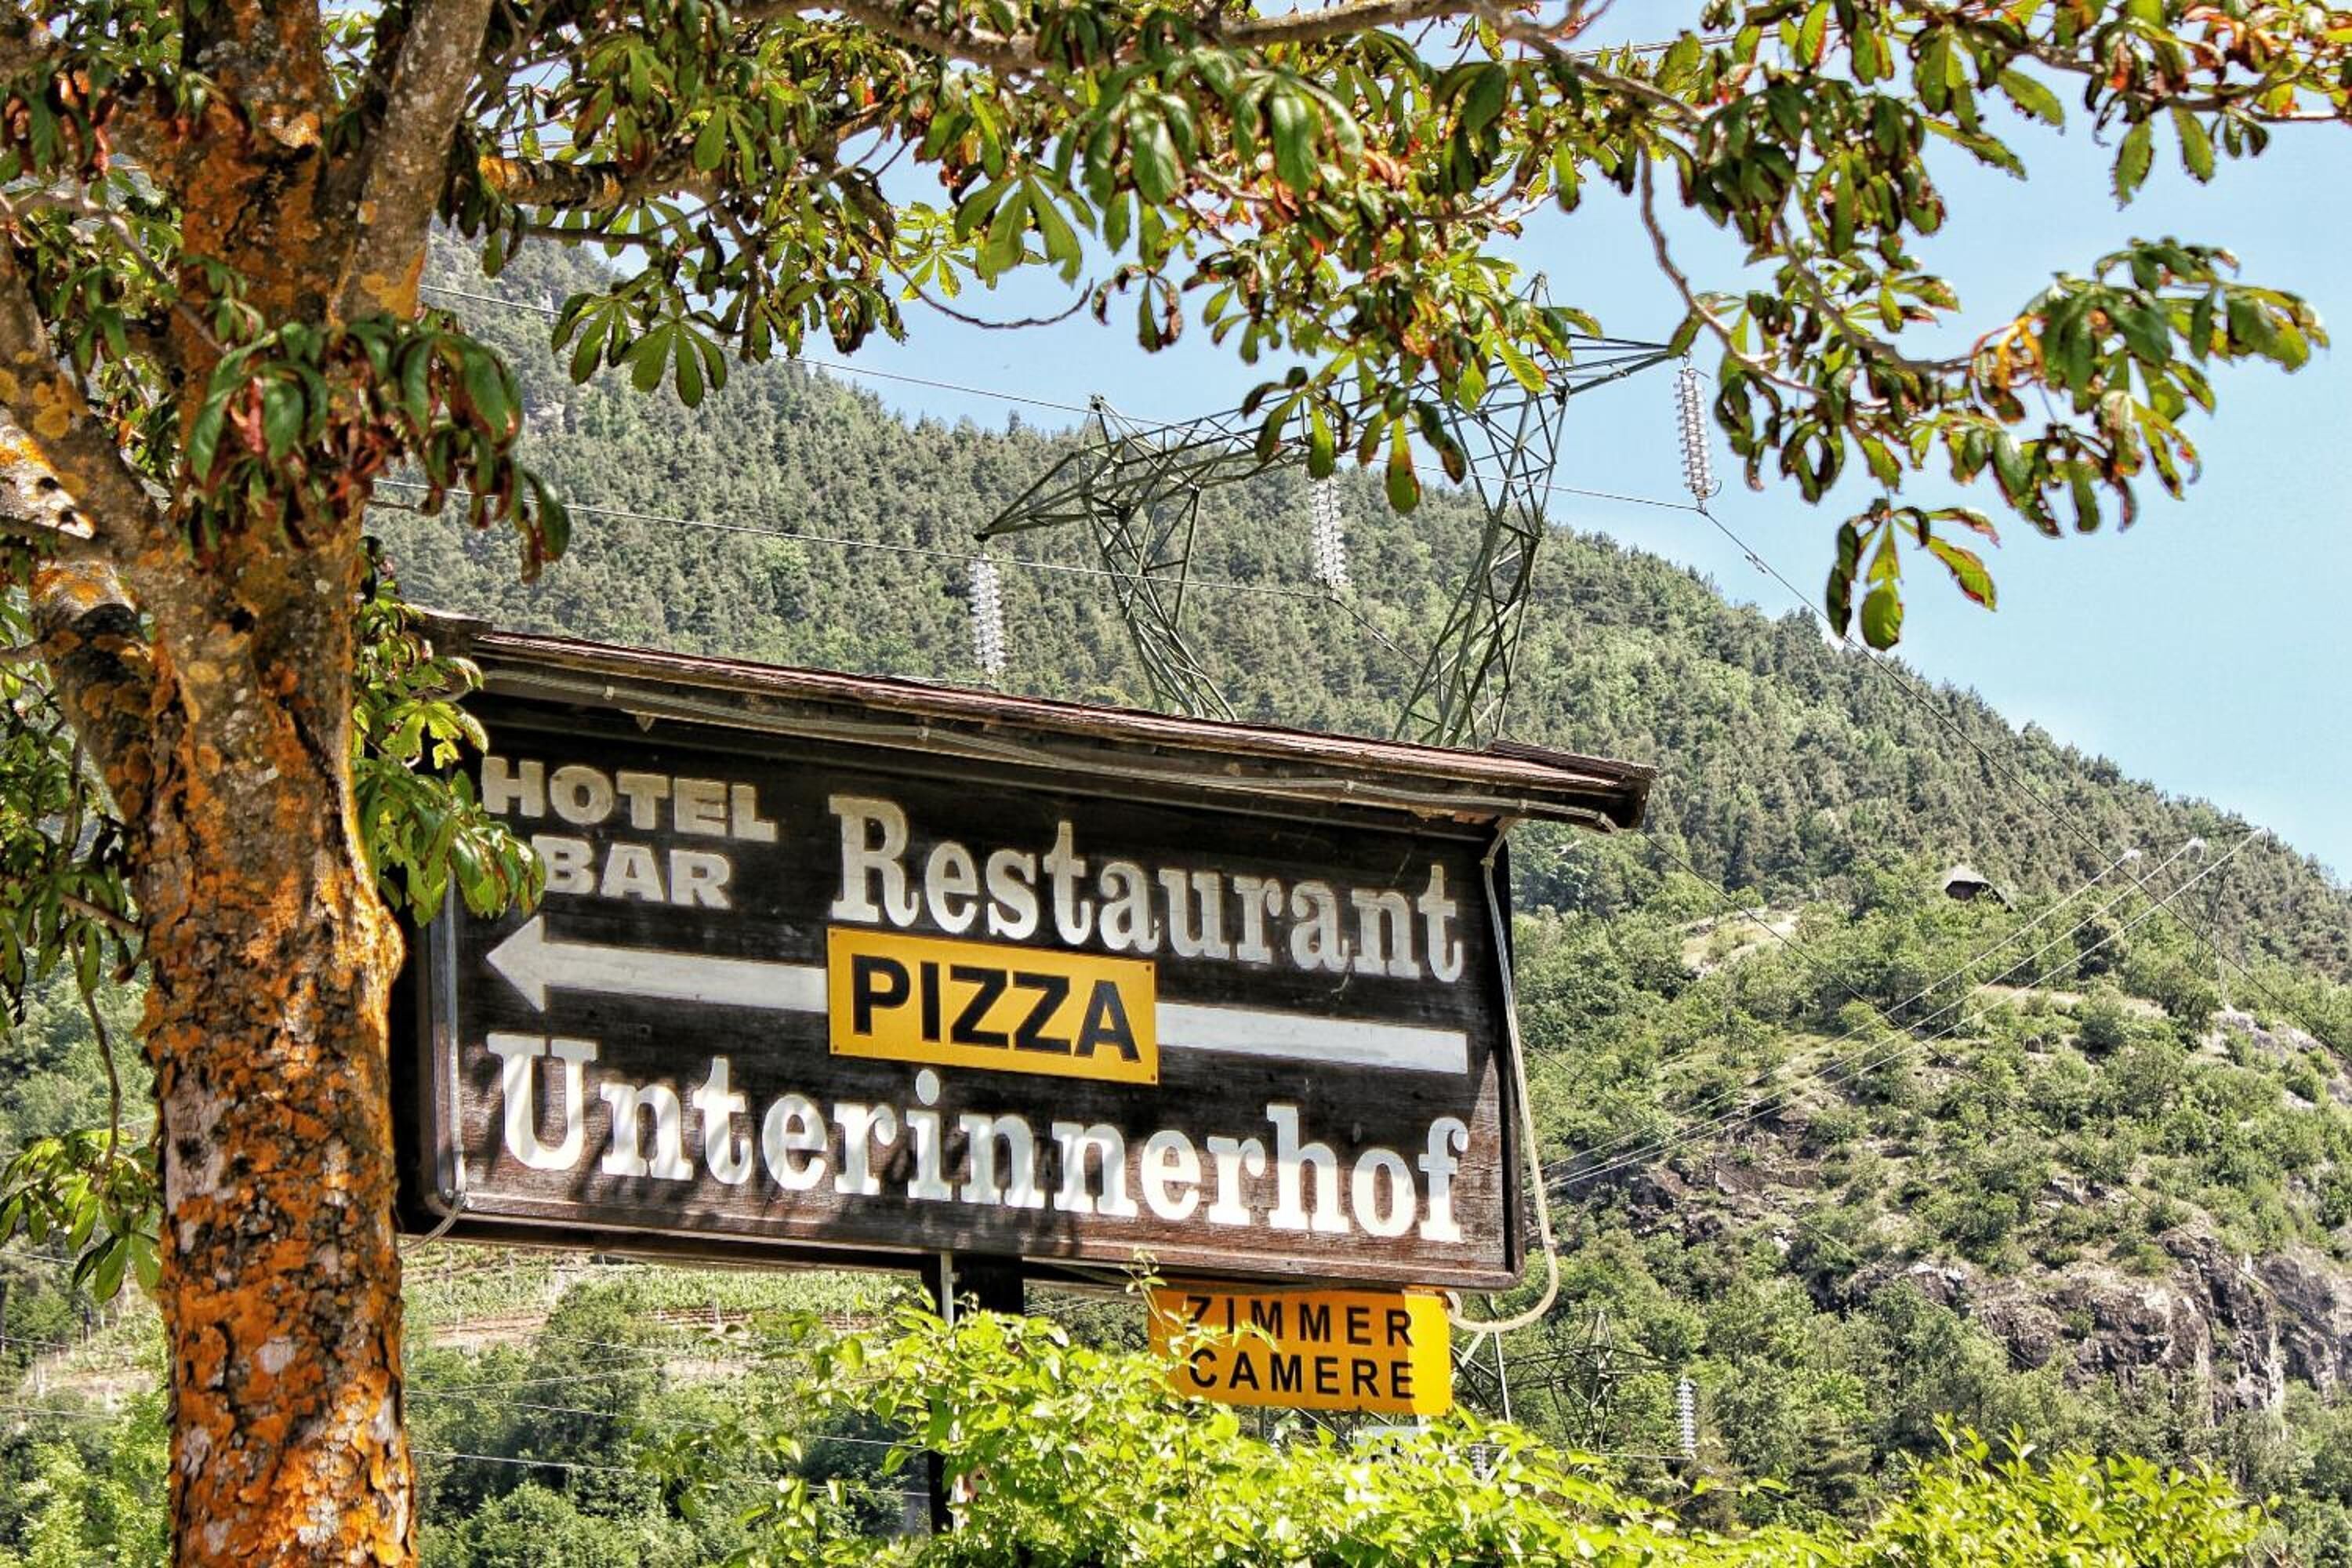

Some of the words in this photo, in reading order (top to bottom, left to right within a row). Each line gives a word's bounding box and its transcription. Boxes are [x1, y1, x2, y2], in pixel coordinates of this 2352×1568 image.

[481, 756, 778, 843] HOTEL
[531, 833, 732, 909] BAR
[829, 794, 1464, 983] Restaurant
[851, 953, 1142, 1063] PIZZA
[486, 1032, 1469, 1243] Unterinnerhof
[1185, 1295, 1414, 1347] ZIMMER
[1189, 1348, 1416, 1399] CAMERE
